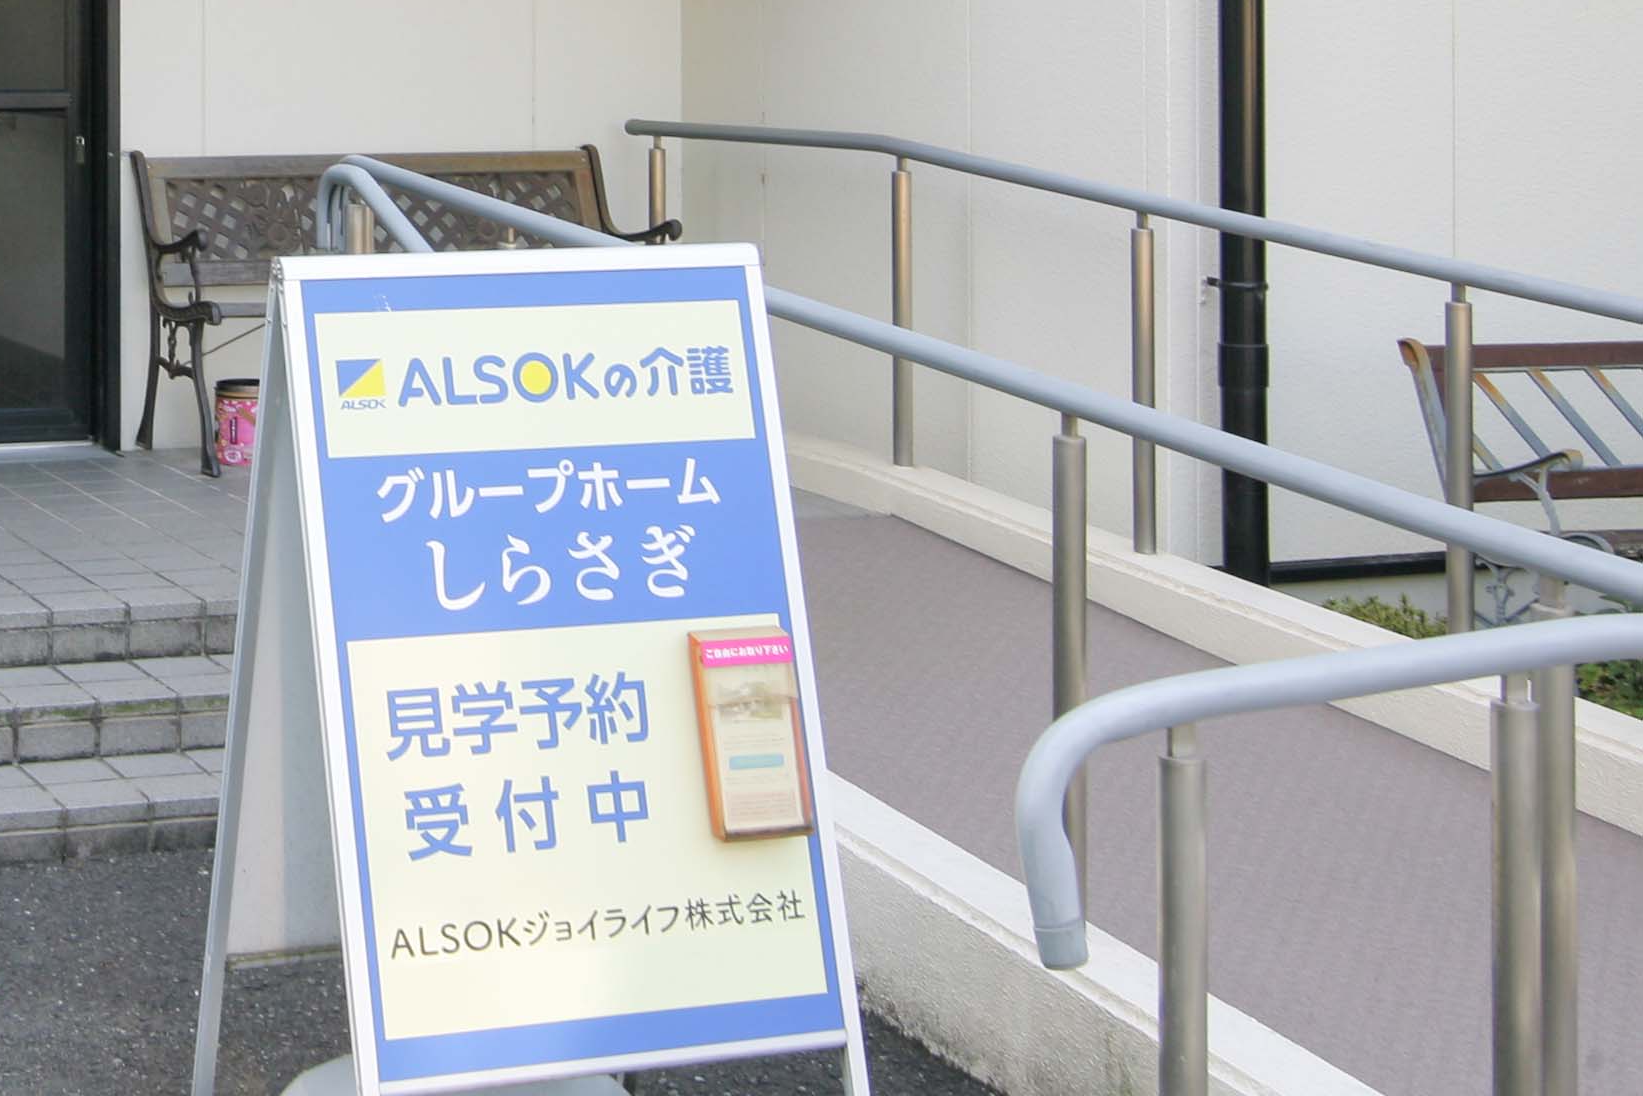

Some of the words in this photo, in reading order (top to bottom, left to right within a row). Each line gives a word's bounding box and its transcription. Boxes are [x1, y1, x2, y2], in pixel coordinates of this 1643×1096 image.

[340, 398, 387, 411] ALSOK
[397, 345, 735, 408] ALSOKの介護
[376, 458, 722, 523] グループホーム
[425, 525, 696, 611] しらさぎ
[385, 672, 651, 761] 見学予約
[404, 770, 650, 862] 受付中
[390, 890, 807, 961] ALSOKジョイライフ株式会社
